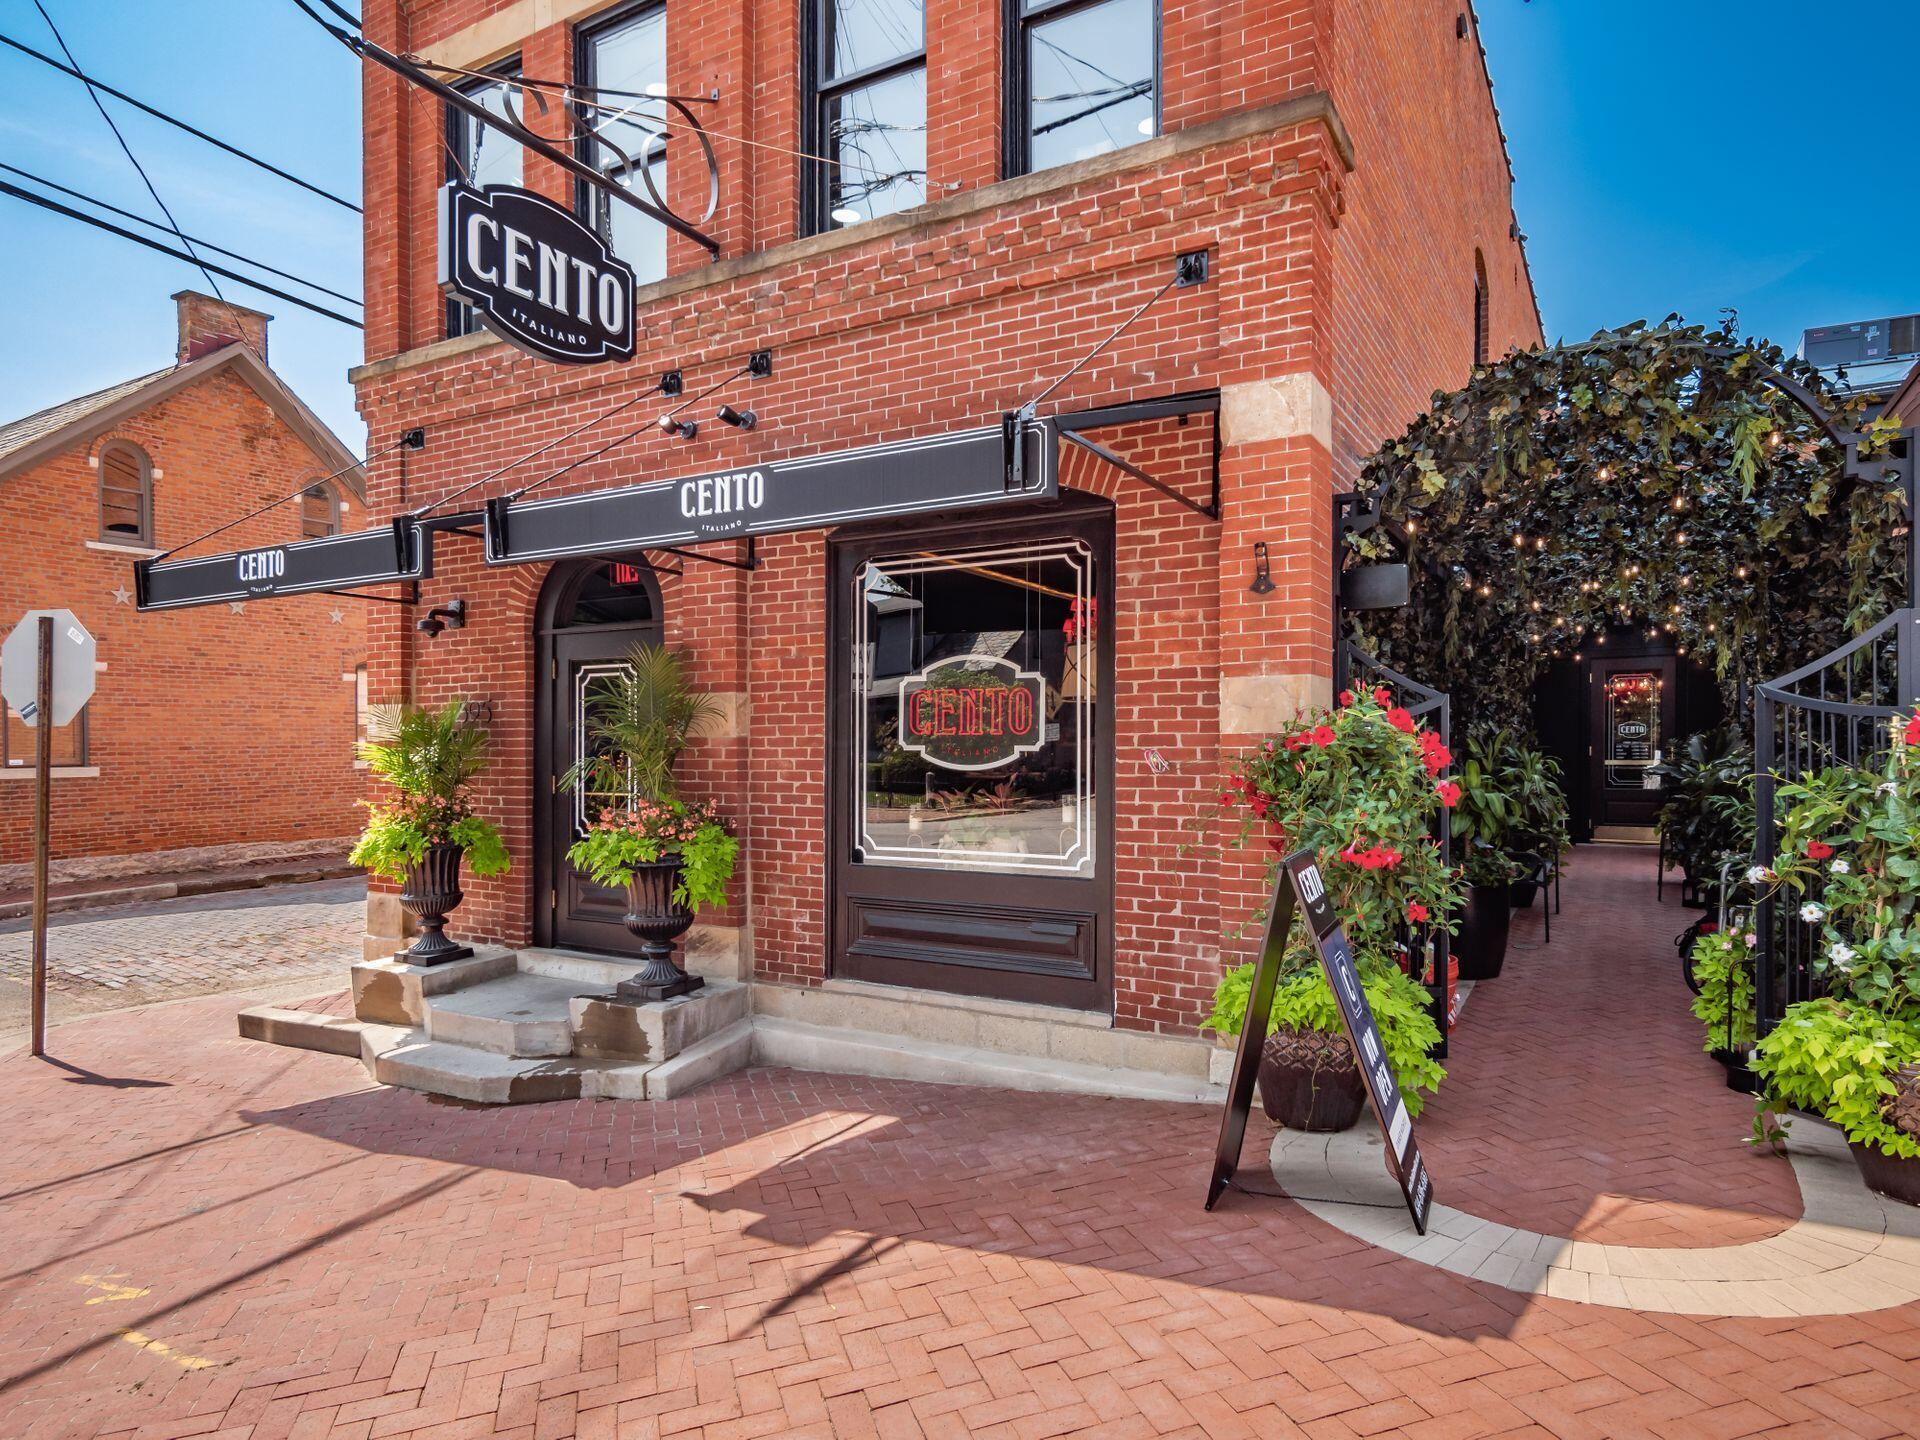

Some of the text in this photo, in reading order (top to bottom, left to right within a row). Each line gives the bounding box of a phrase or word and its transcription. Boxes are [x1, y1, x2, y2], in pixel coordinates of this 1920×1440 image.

[467, 213, 624, 336] CENTO
[512, 307, 587, 346] ITALIANO
[680, 471, 765, 518] CENTO
[701, 519, 742, 532] ITALIANO
[239, 549, 285, 581] CENTO
[909, 687, 1033, 737] CENTO
[1620, 725, 1644, 734] CENTO
[1297, 864, 1325, 904] CENTO
